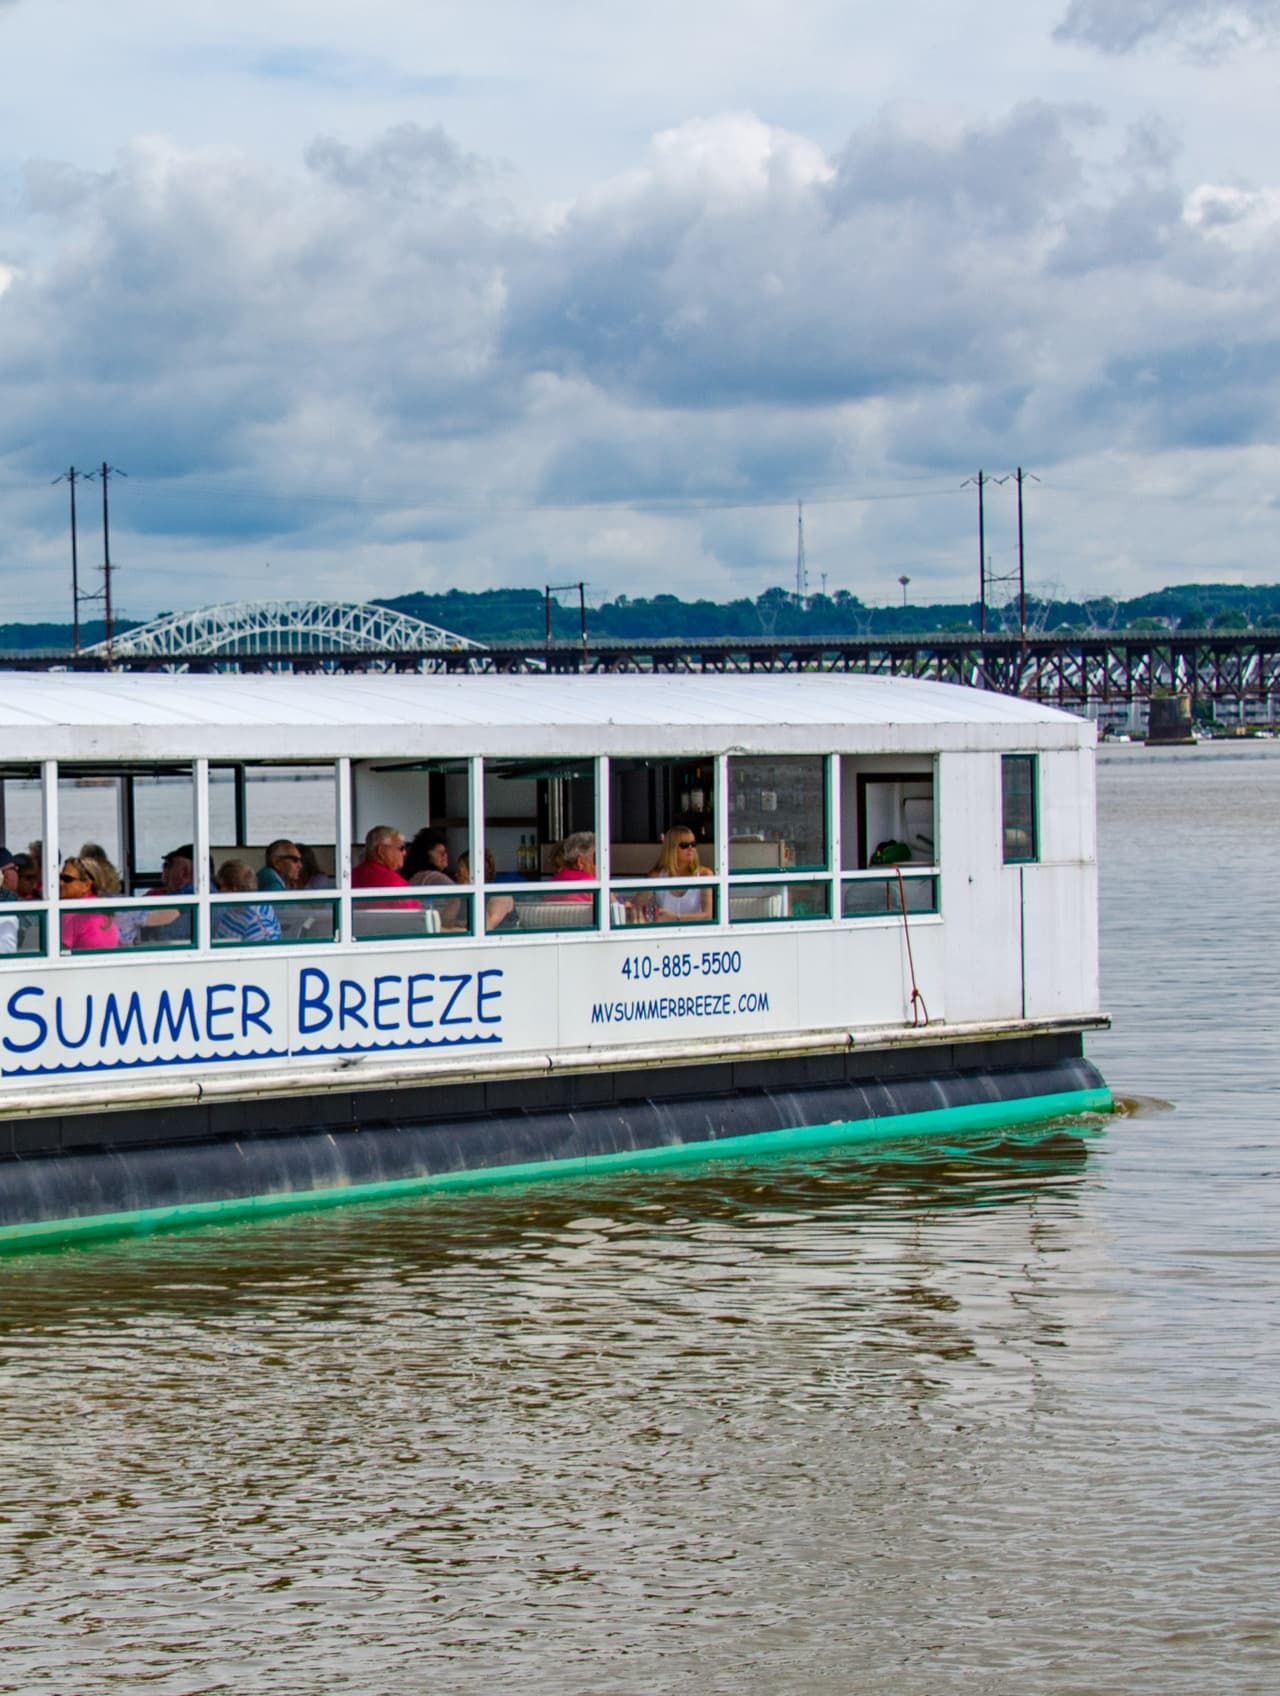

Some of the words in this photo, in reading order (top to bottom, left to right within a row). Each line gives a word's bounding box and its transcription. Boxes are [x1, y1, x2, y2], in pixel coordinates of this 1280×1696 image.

[621, 950, 742, 980] 410-885-5500
[2, 983, 273, 1054] SUMMER
[297, 966, 505, 1035] BREEZE
[591, 992, 769, 1024] MVSUMMERBREEZE.COM
